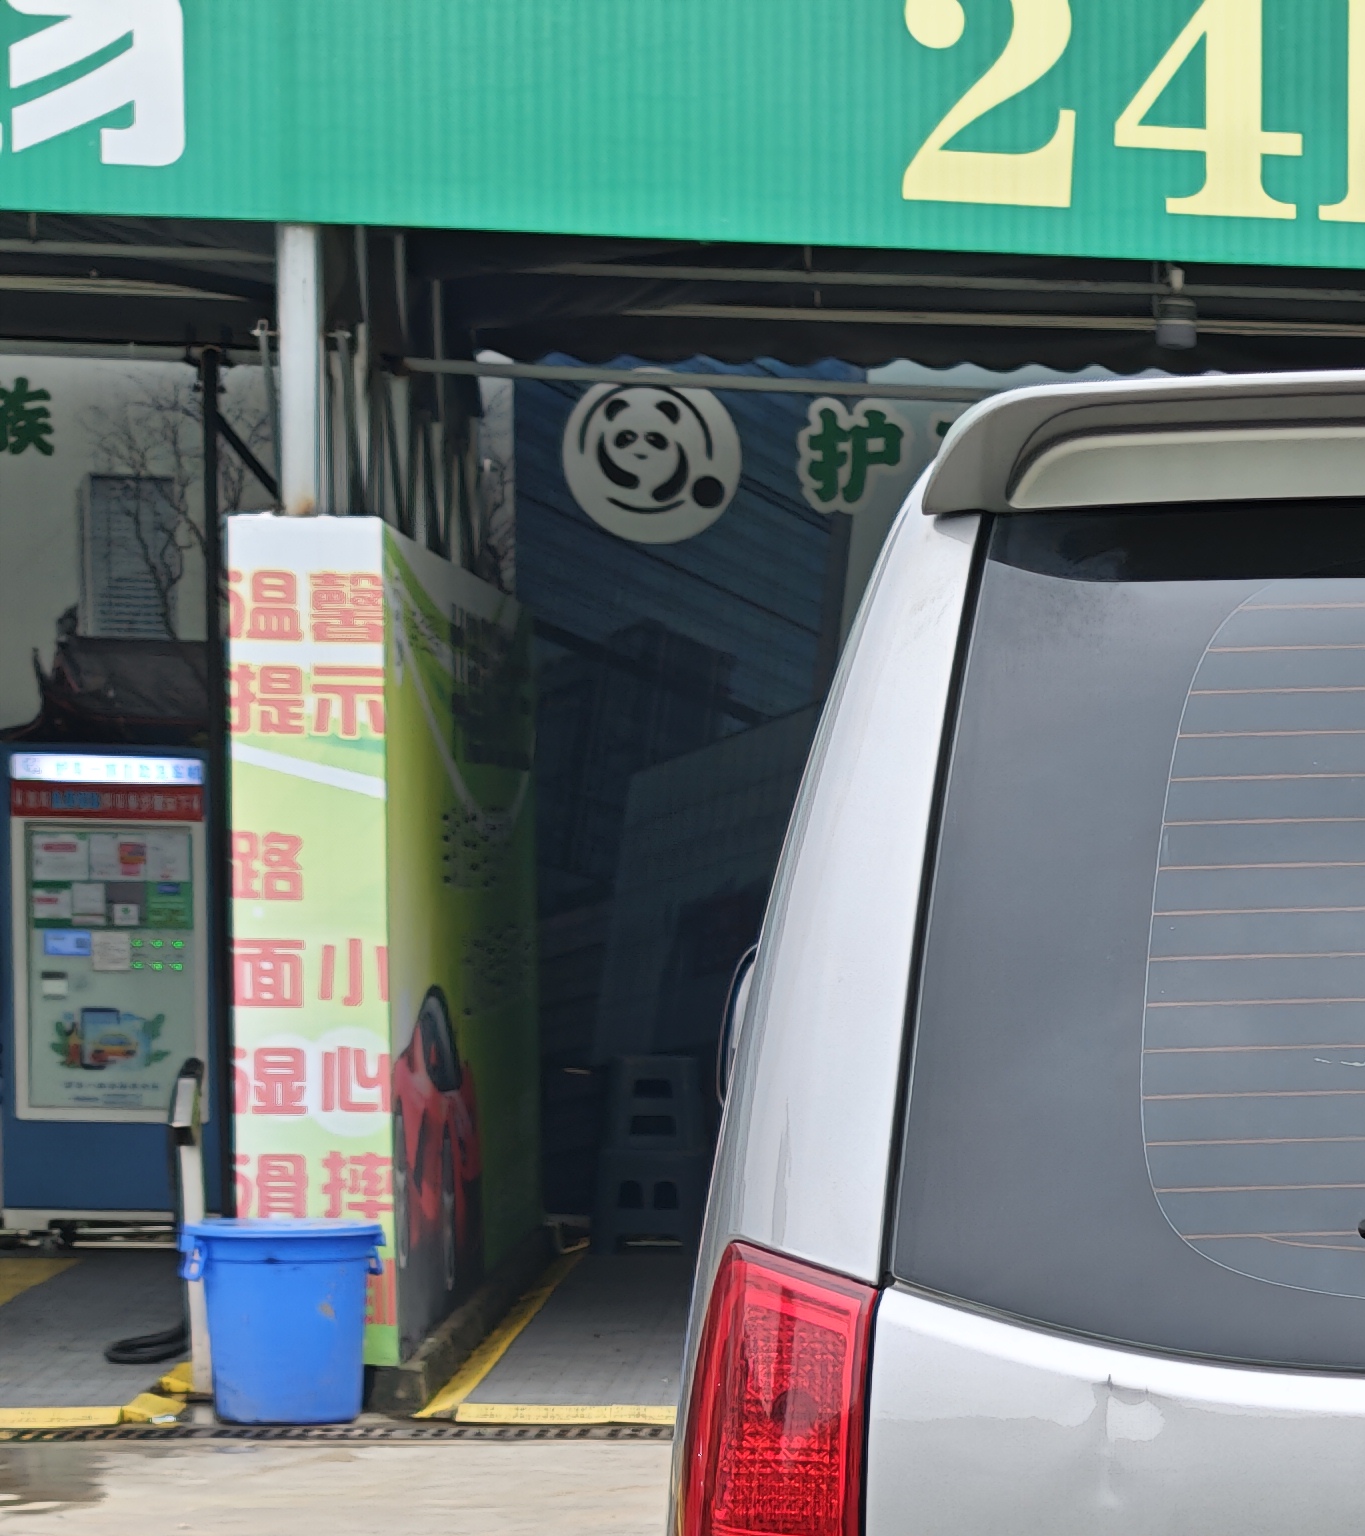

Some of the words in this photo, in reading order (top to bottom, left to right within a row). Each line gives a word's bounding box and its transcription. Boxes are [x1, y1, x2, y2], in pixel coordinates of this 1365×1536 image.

[808, 407, 957, 503] 护
[229, 570, 385, 642] 温馨
[230, 663, 386, 738] 提示
